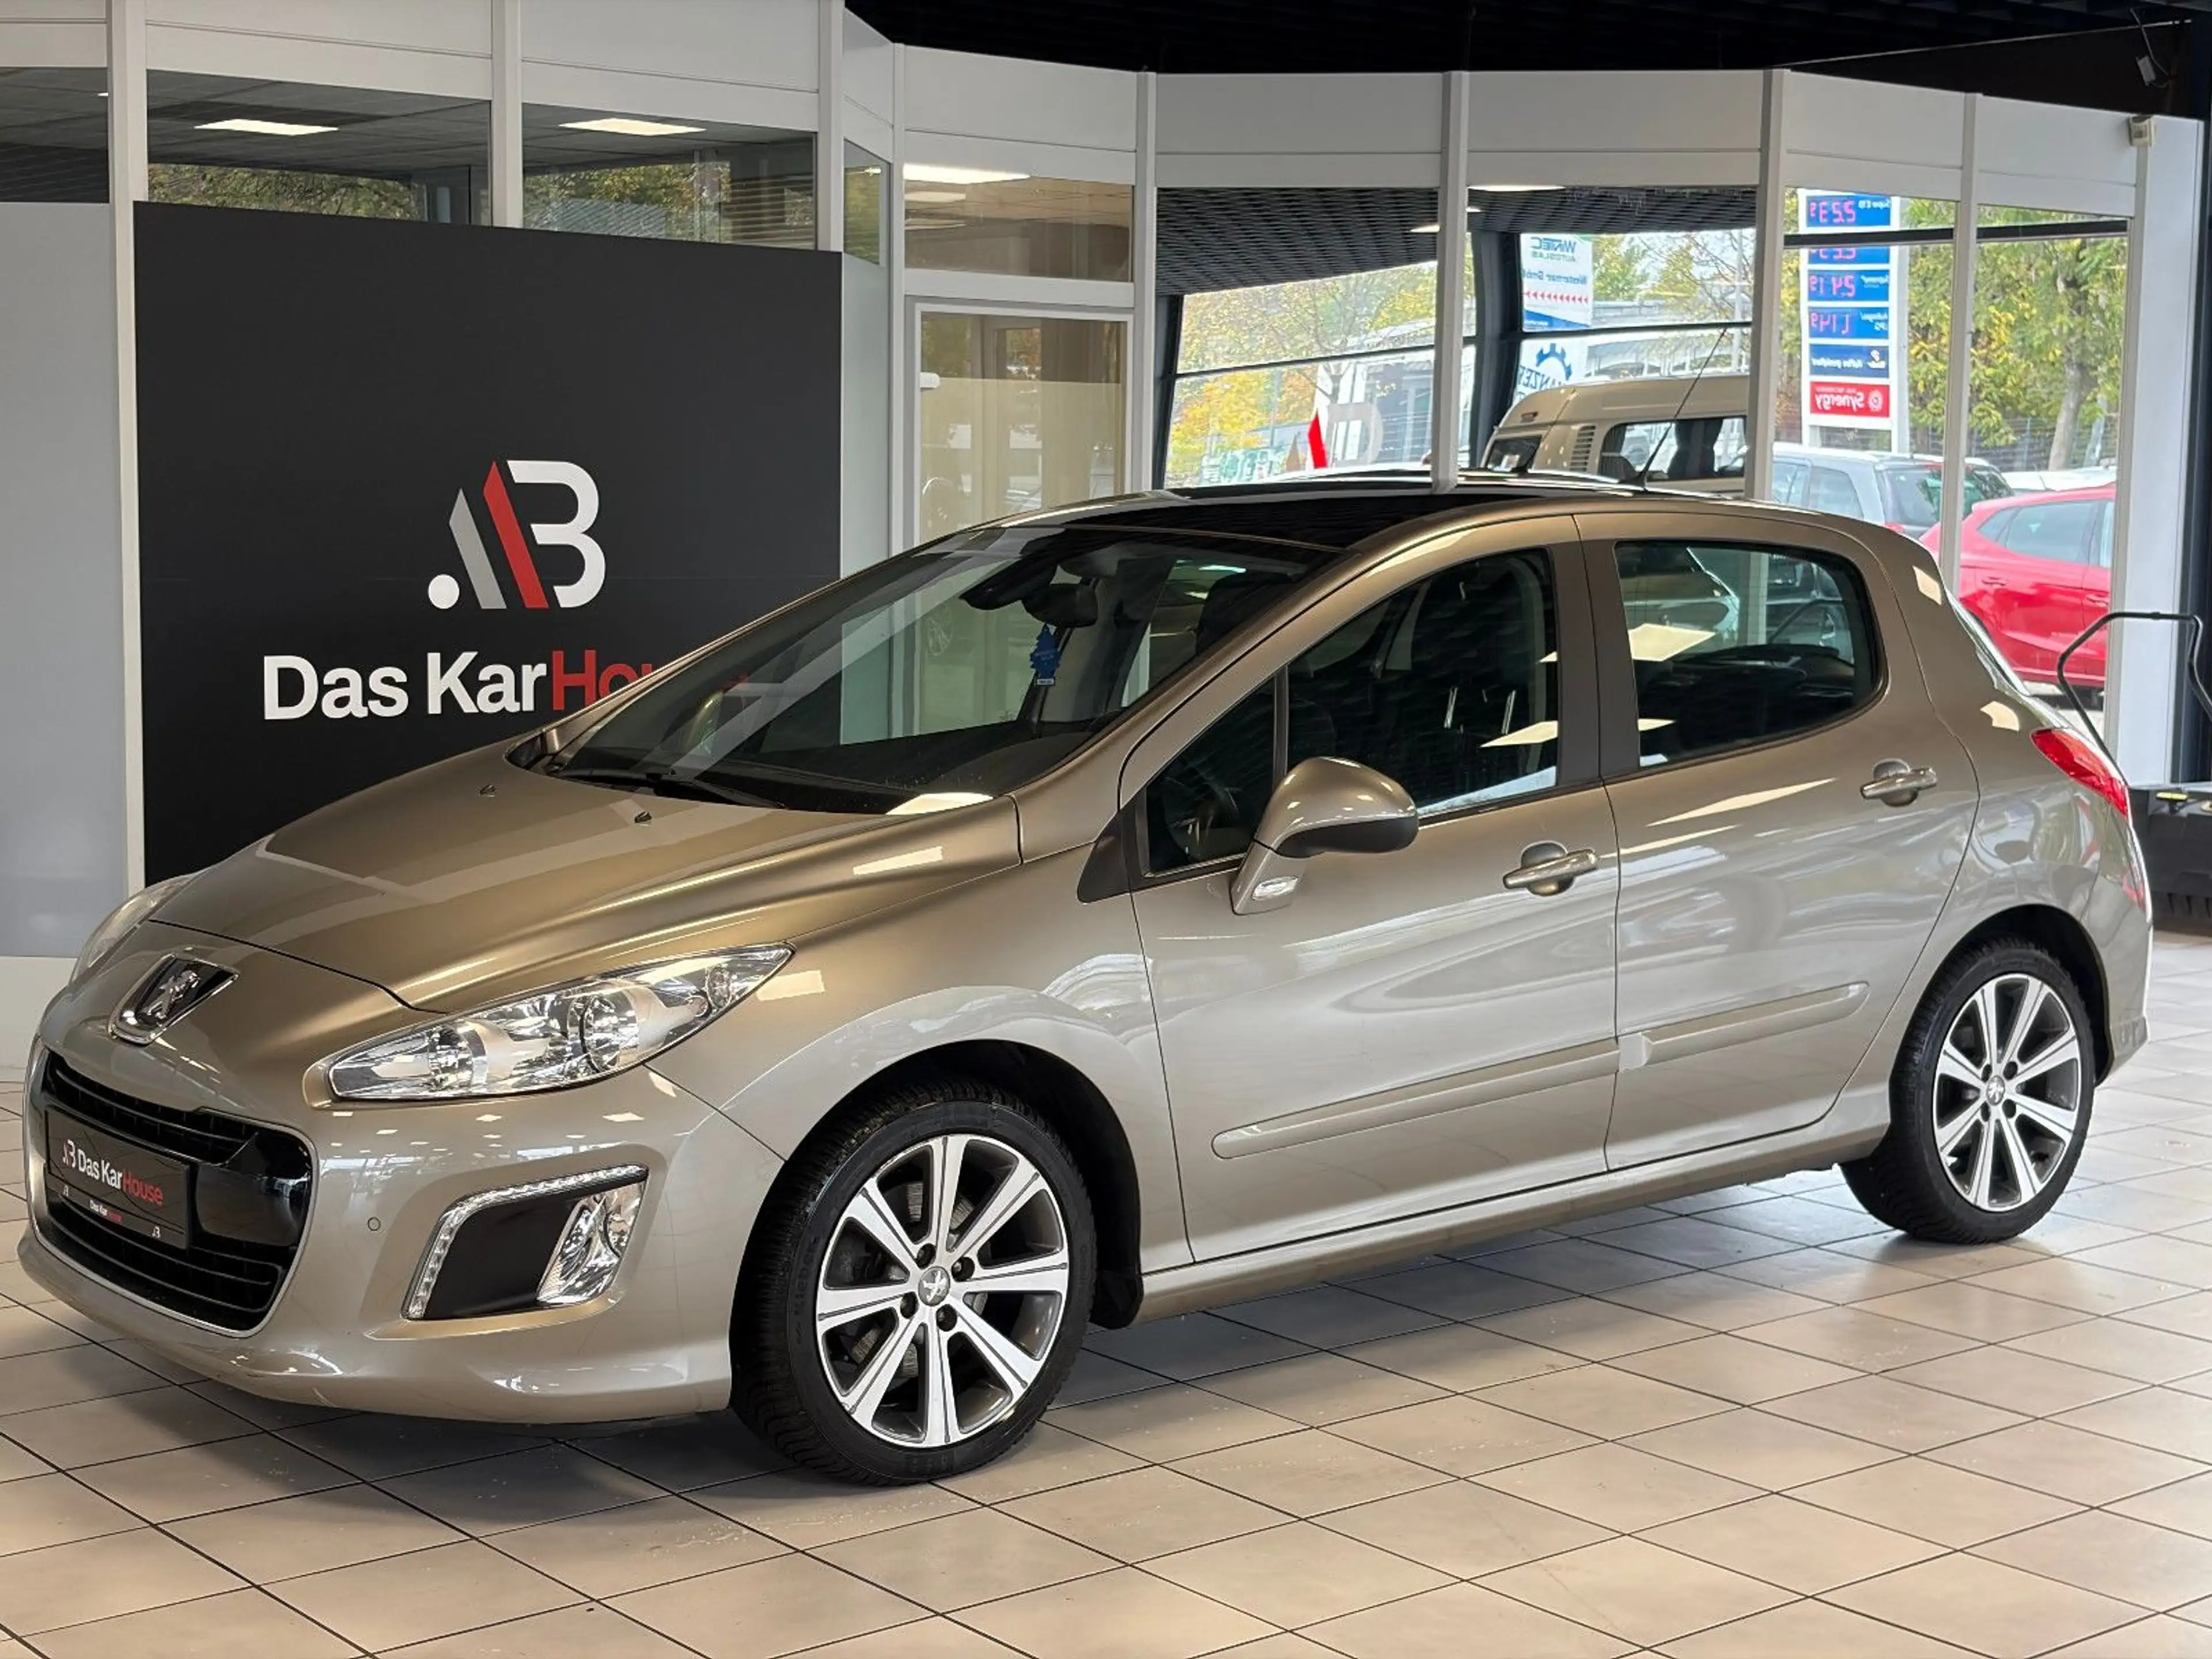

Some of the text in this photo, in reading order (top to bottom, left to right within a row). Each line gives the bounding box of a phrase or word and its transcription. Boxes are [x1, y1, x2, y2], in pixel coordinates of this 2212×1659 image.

[263, 655, 408, 720] Das
[77, 1149, 100, 1180] Das
[100, 1159, 164, 1207] KarHouse
